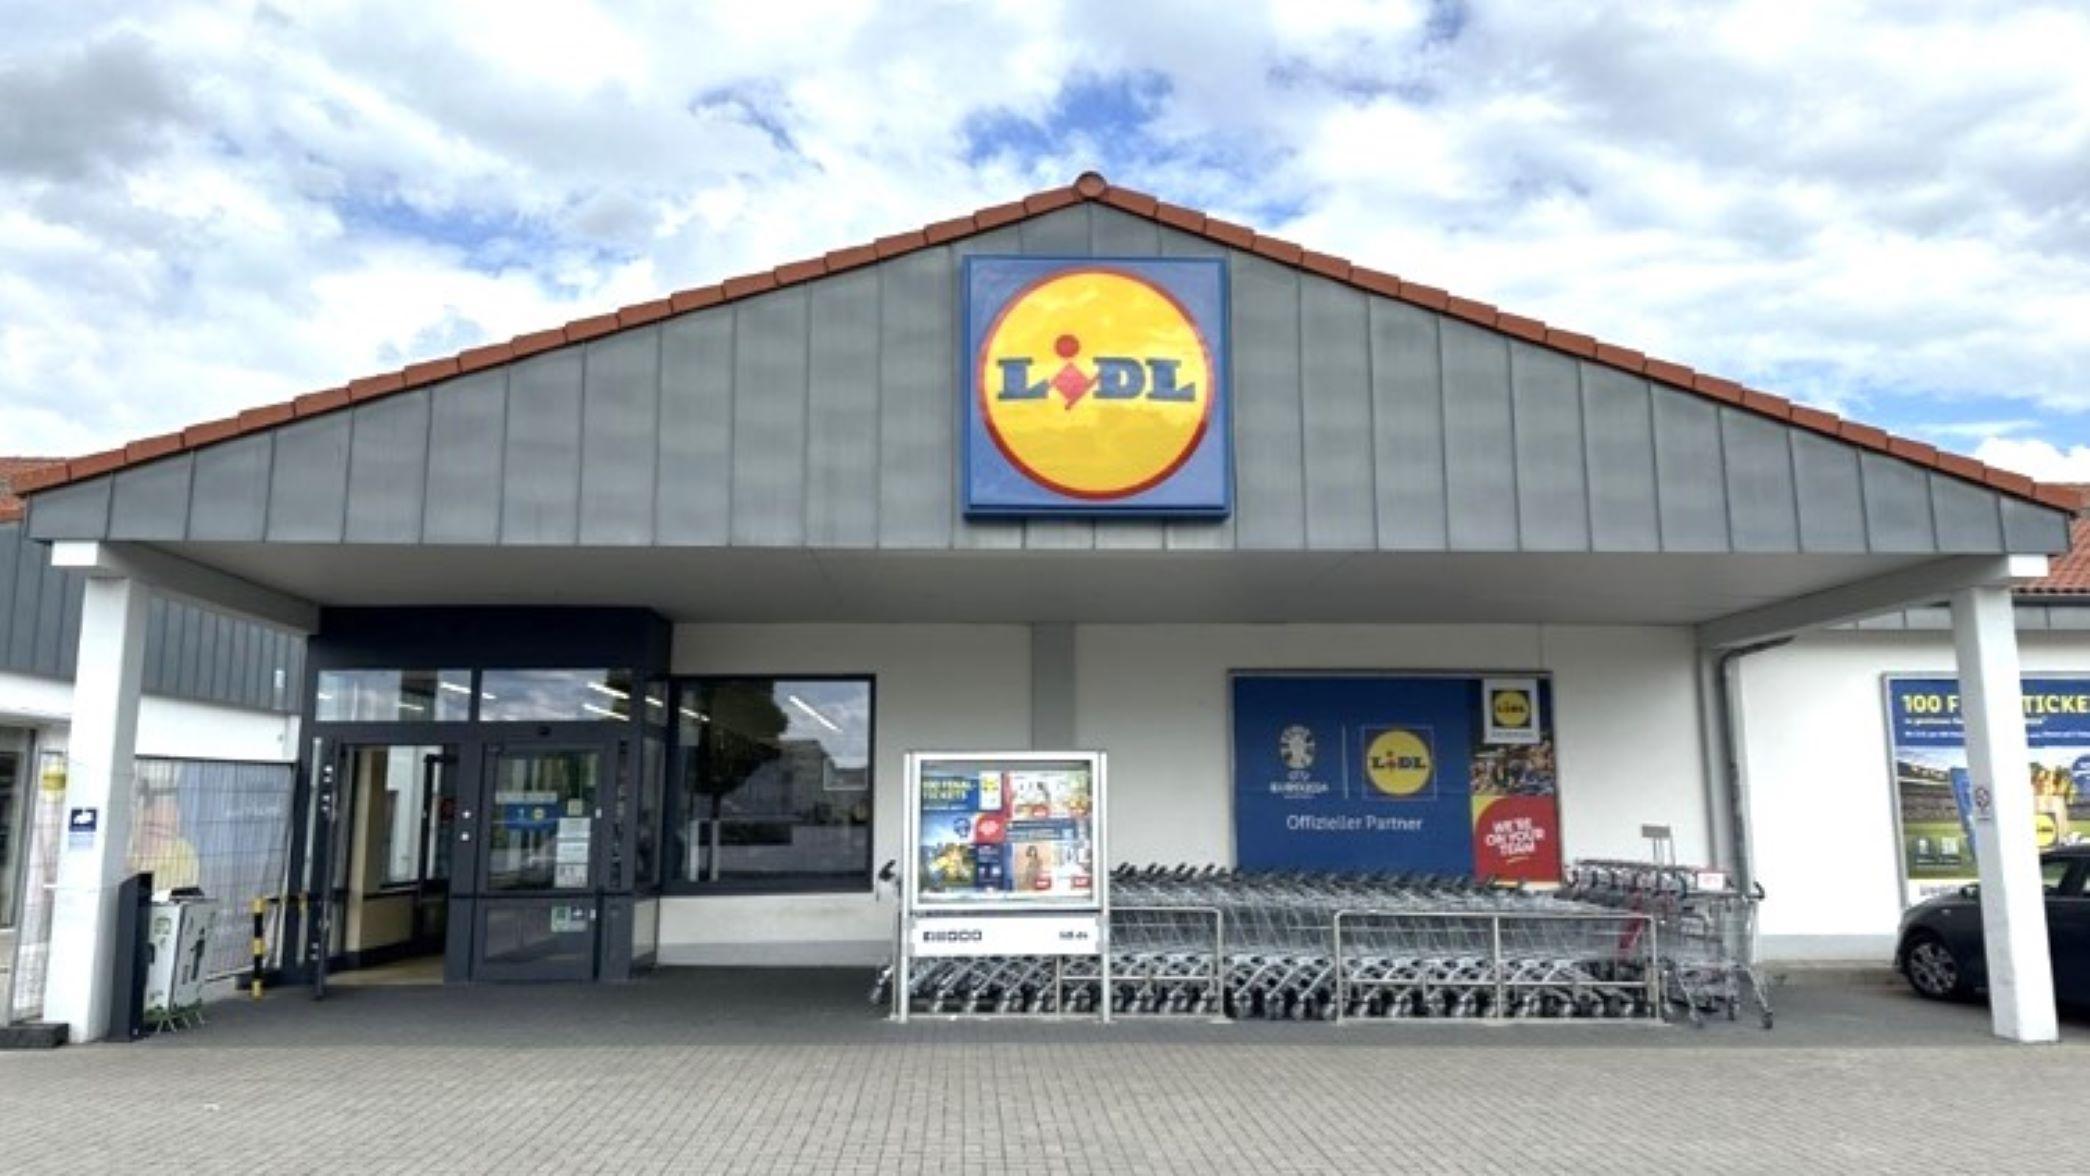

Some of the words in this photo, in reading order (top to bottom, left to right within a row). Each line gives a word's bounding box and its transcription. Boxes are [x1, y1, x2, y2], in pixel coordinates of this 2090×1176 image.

[1902, 694, 1942, 713] 100
[1286, 814, 1362, 830] Offizieller
[1366, 815, 1422, 830] Partner
